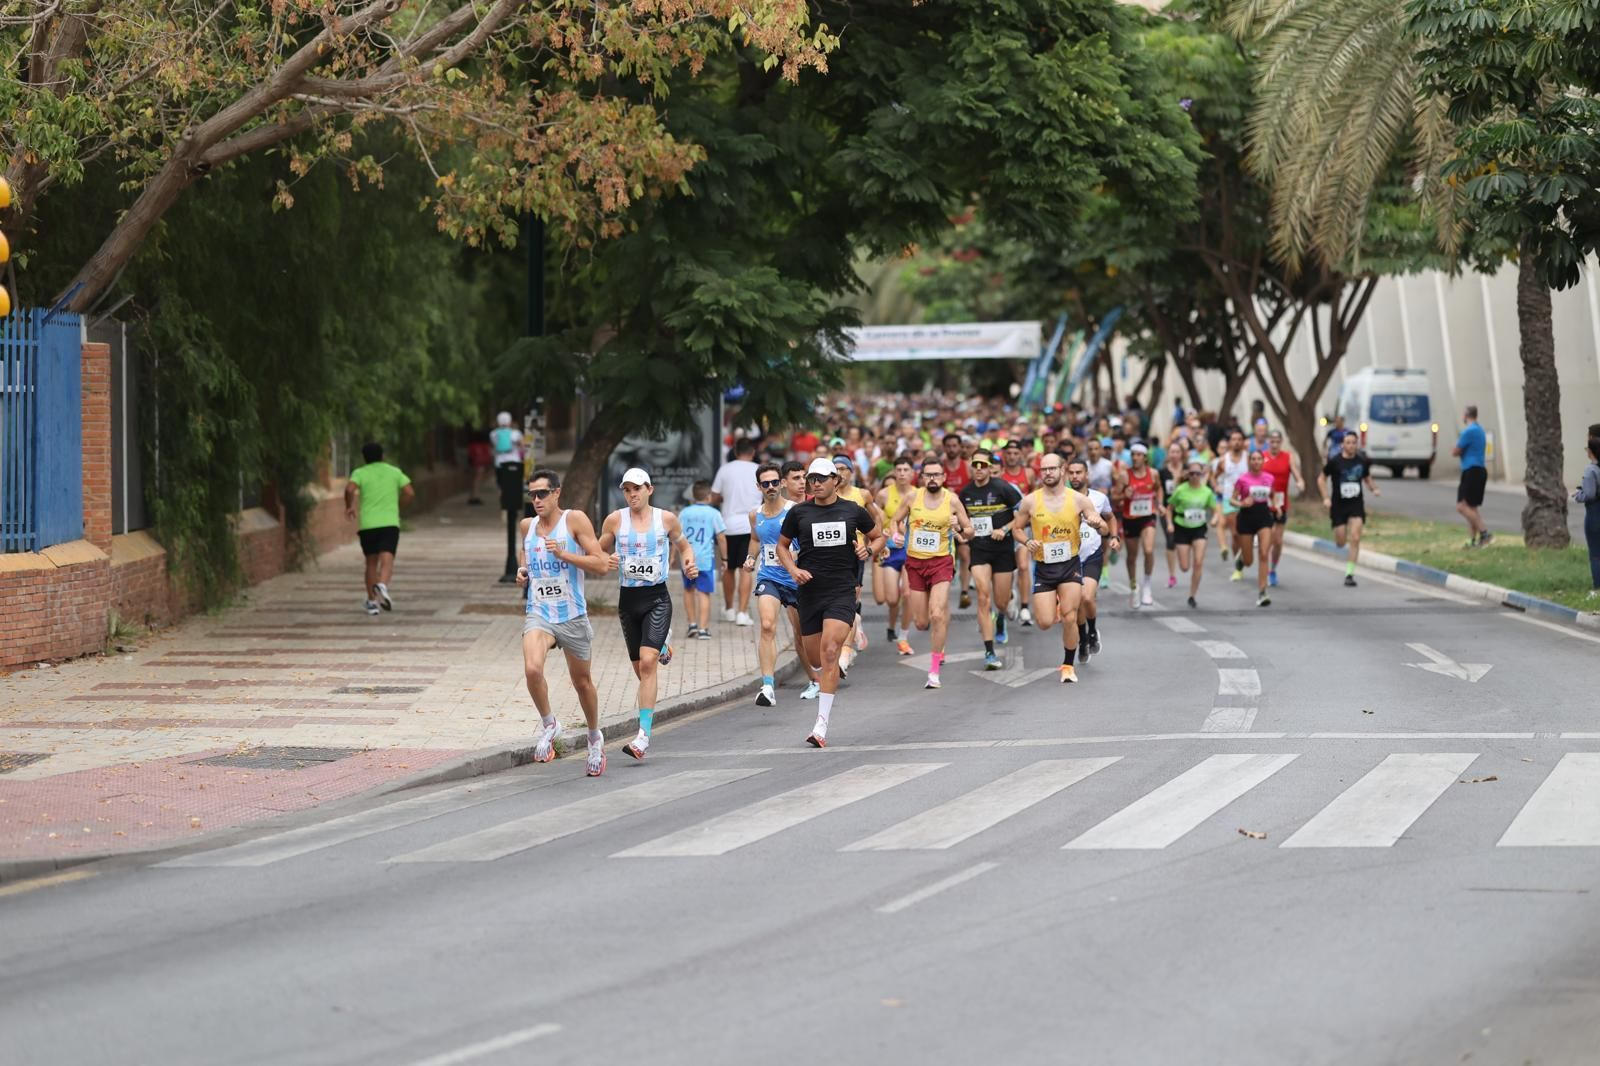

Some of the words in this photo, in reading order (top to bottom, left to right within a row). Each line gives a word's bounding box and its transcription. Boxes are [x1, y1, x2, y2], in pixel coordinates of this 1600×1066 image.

[686, 526, 705, 545] 24
[817, 529, 841, 540] 859
[916, 537, 936, 546] 692
[1050, 548, 1064, 557] 33
[629, 565, 654, 574] 344
[537, 585, 562, 597] 125
